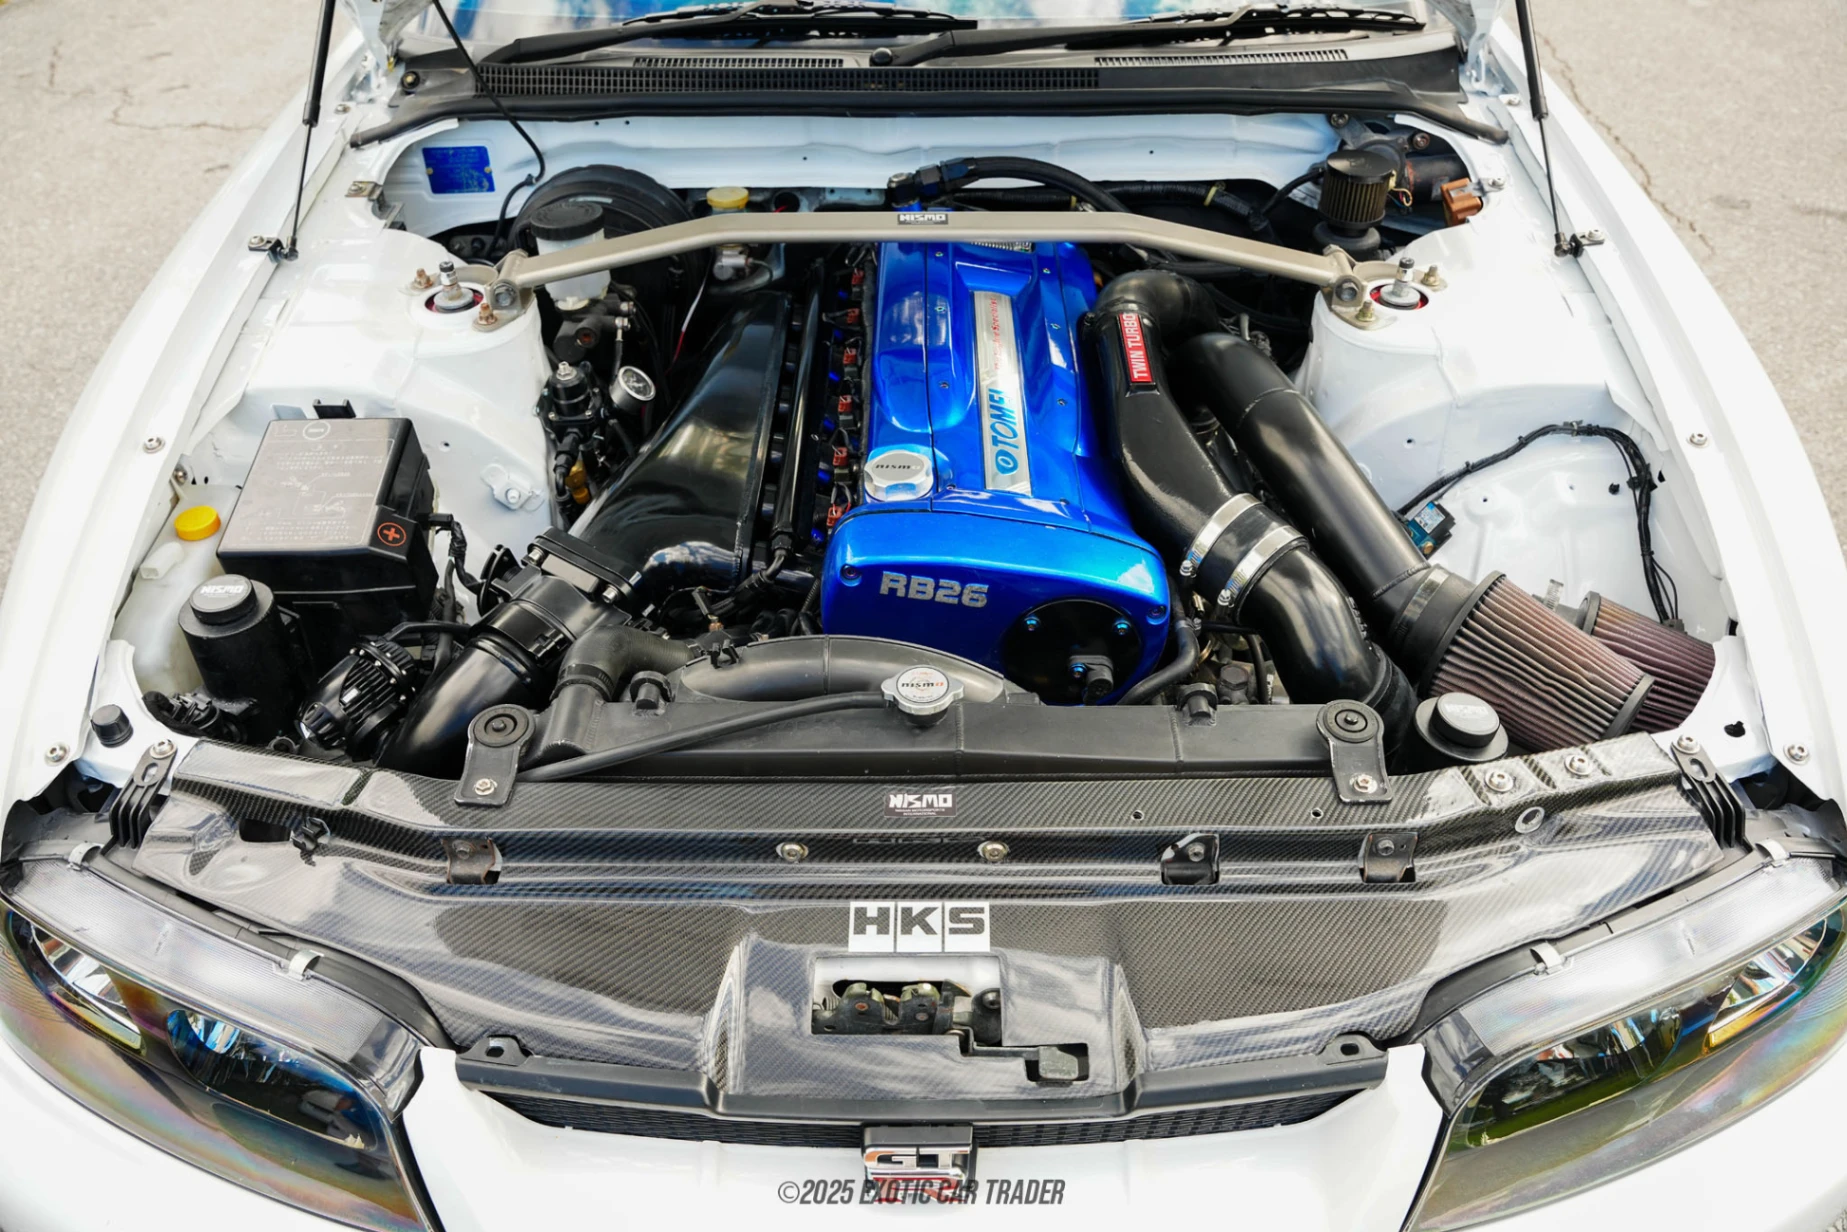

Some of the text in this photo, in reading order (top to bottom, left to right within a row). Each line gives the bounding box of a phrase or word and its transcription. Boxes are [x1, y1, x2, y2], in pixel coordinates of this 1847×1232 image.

[899, 214, 947, 222] NISMO
[1122, 312, 1149, 379] TWIN TURBO
[880, 571, 989, 608] RB26
[889, 793, 953, 808] NISMO
[852, 906, 986, 936] HKS
[864, 1146, 970, 1170] GT
